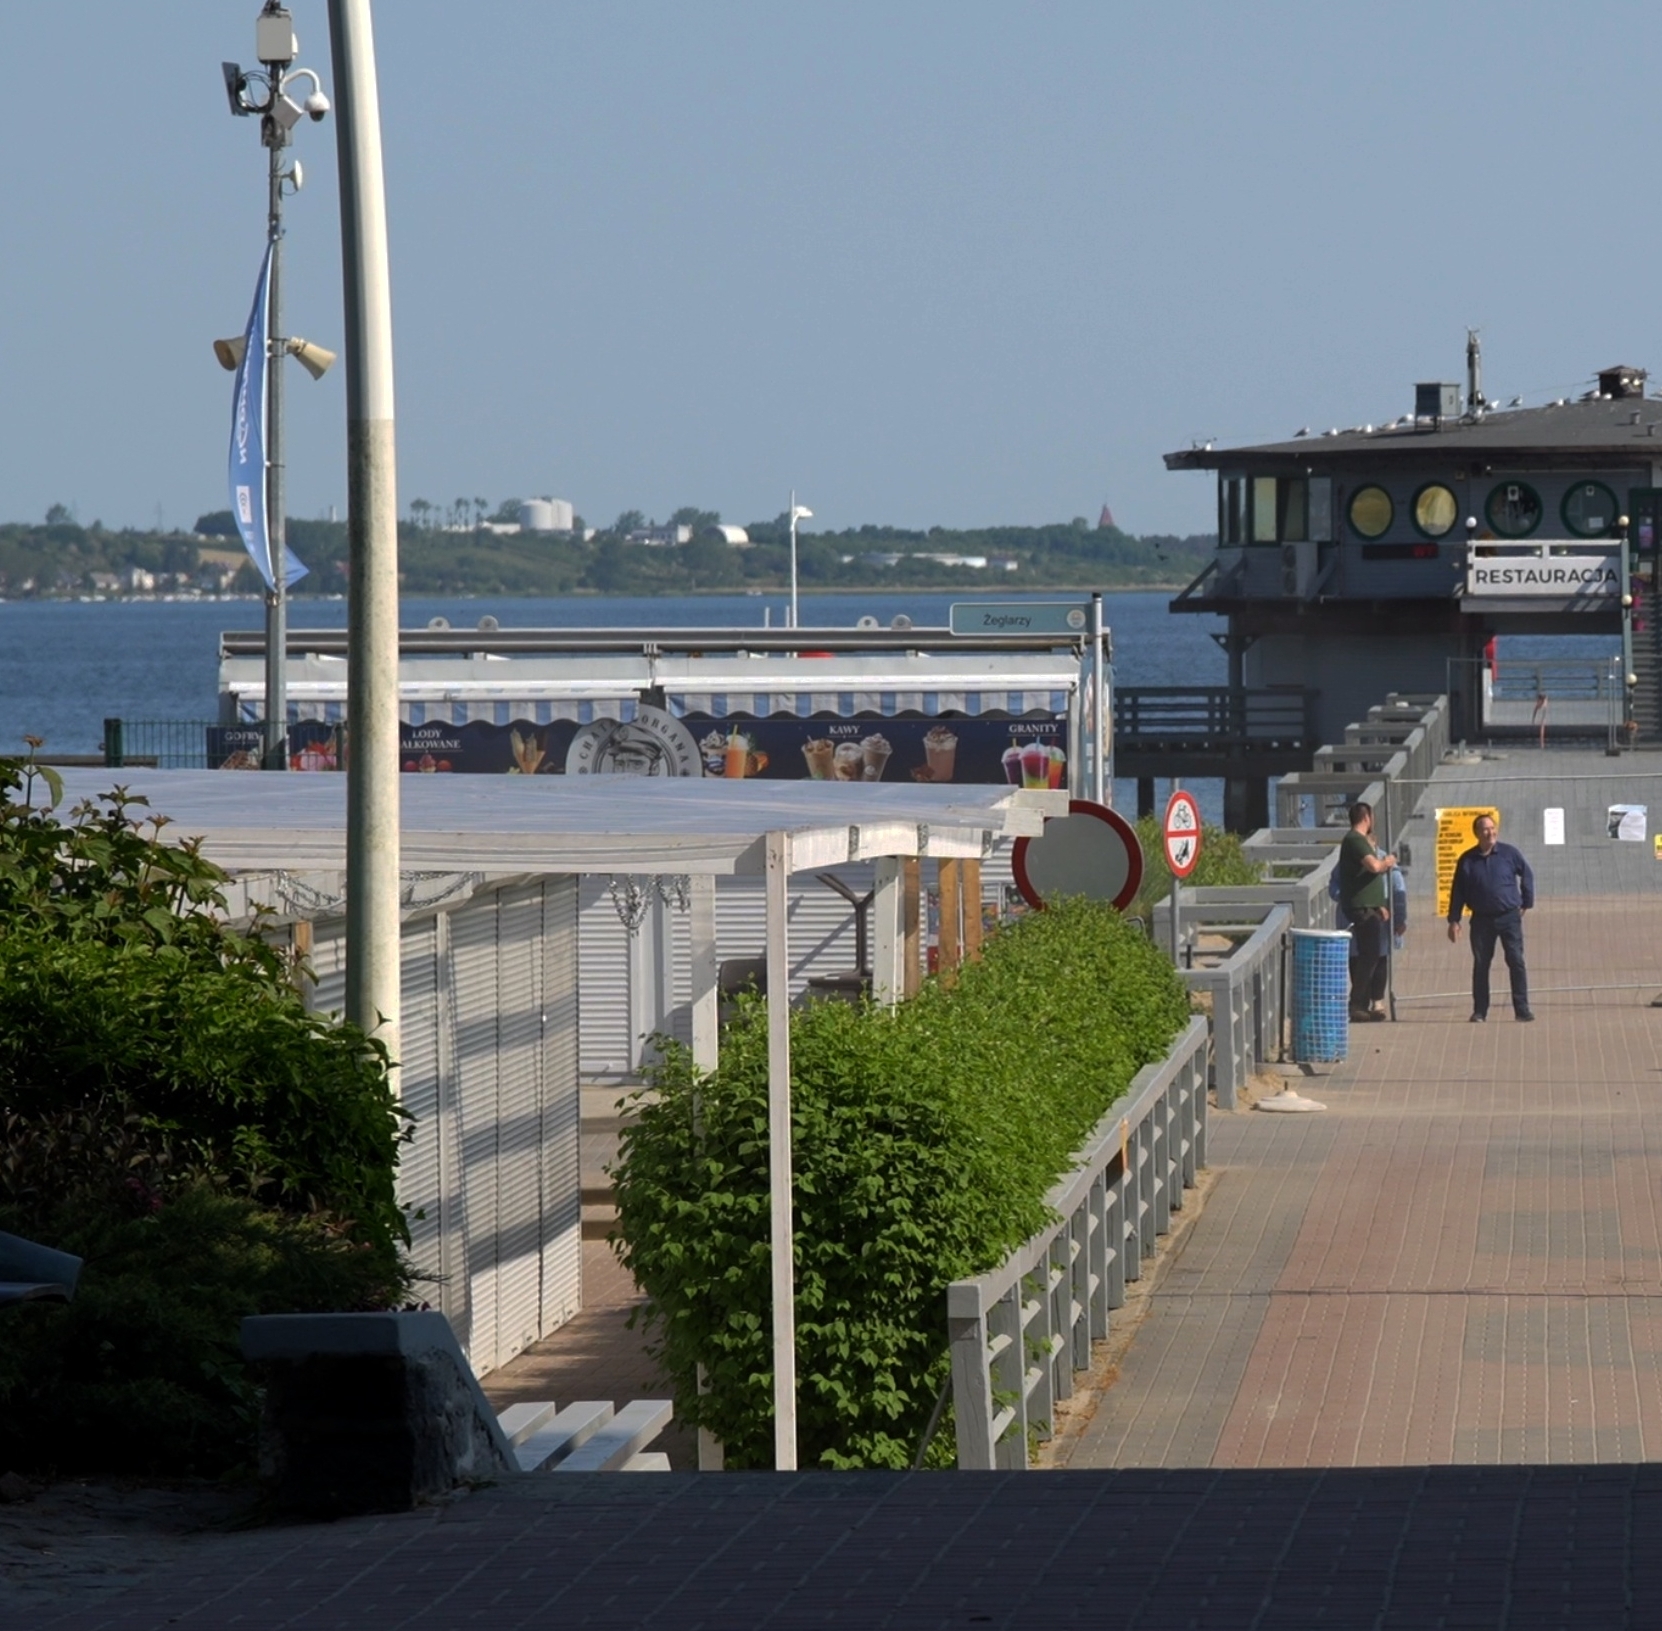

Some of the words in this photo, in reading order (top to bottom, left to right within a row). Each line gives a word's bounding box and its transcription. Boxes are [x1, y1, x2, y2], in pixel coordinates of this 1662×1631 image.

[1475, 568, 1618, 584] RESTAURACJA
[982, 612, 1032, 627] Żeglarzy
[829, 725, 860, 735] KAWY
[1008, 723, 1059, 733] GRANITY
[411, 729, 442, 739] LODY
